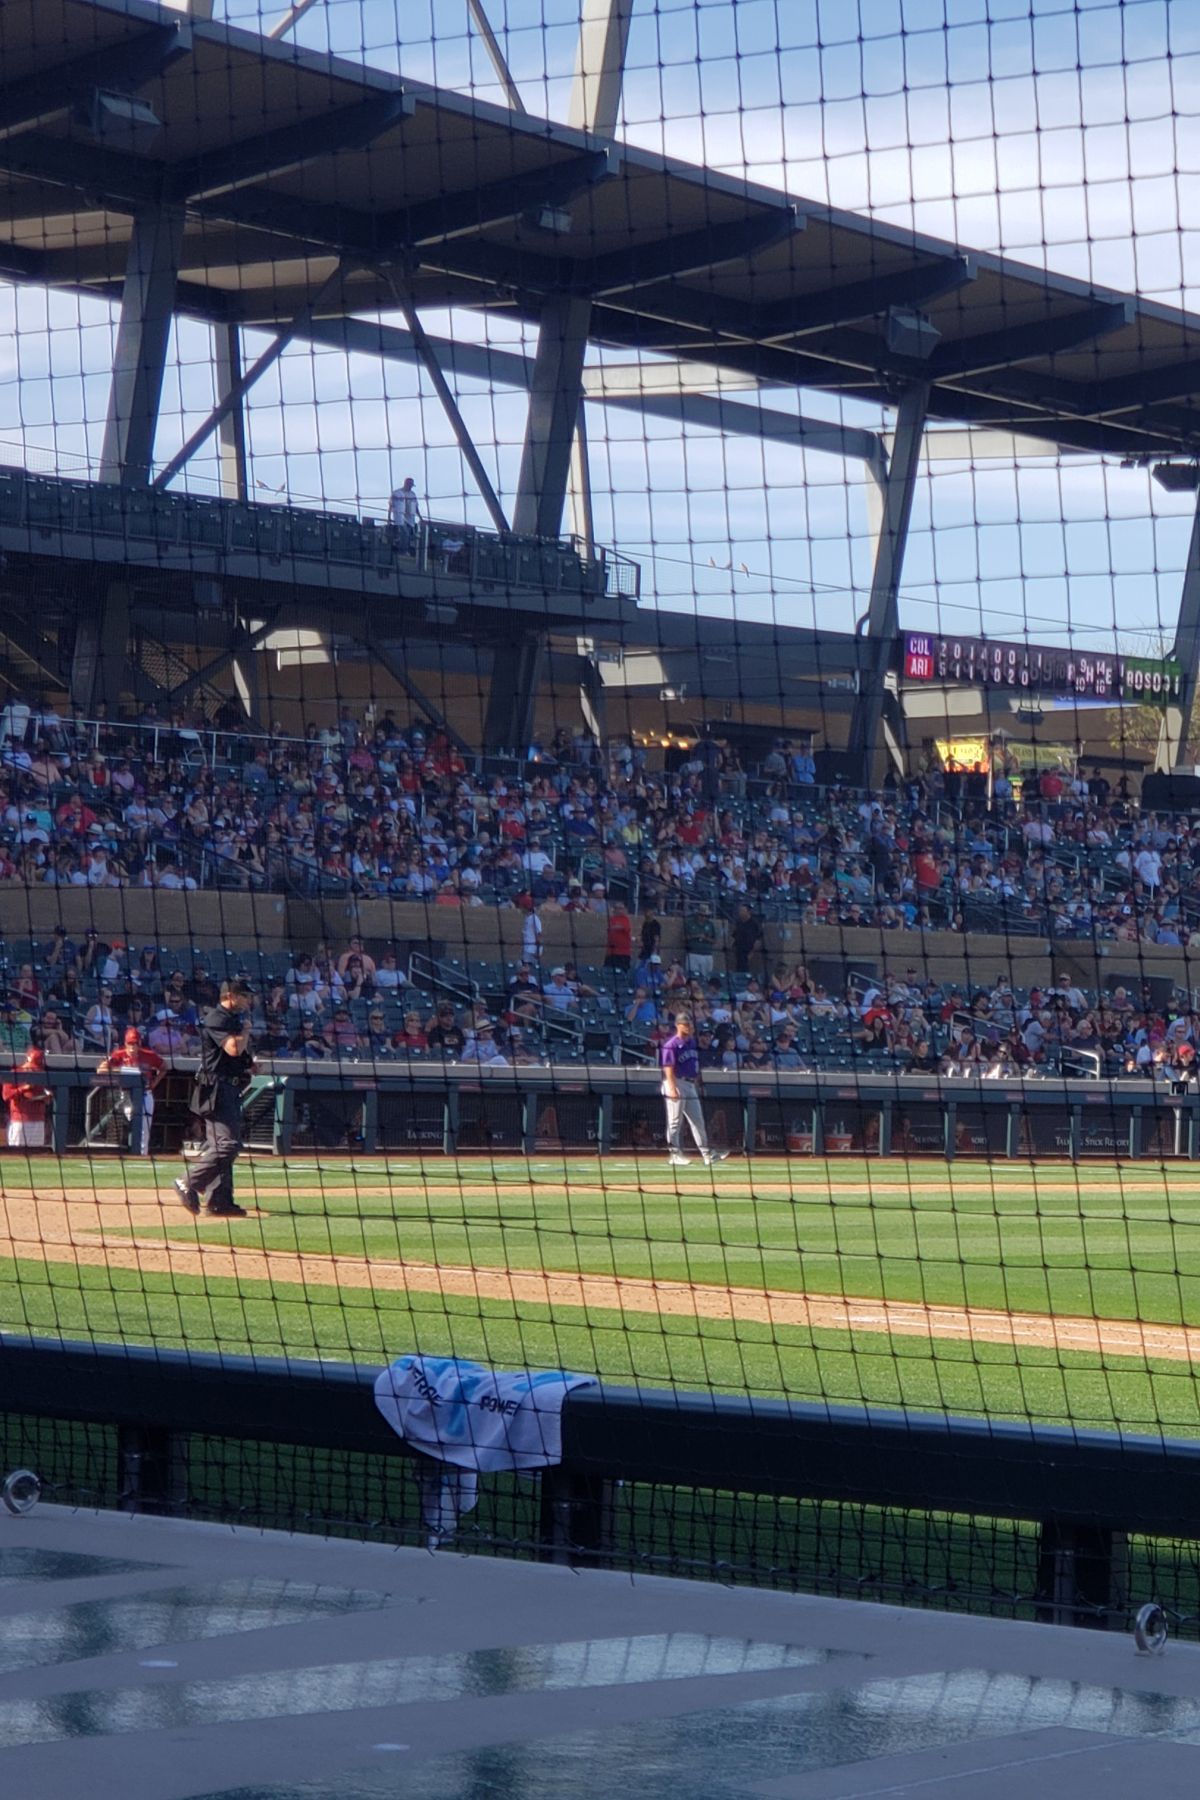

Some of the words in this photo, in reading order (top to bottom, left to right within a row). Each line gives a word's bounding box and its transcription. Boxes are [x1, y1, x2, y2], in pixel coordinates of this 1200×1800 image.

[910, 637, 930, 656] COL
[953, 643, 961, 660] 0
[994, 648, 1001, 664] 0
[1009, 649, 1016, 665] 0
[910, 656, 929, 677] ARI
[993, 666, 1001, 683] 0
[1008, 668, 1015, 684] 2
[1021, 670, 1029, 687] 0
[1105, 666, 1113, 685] E
